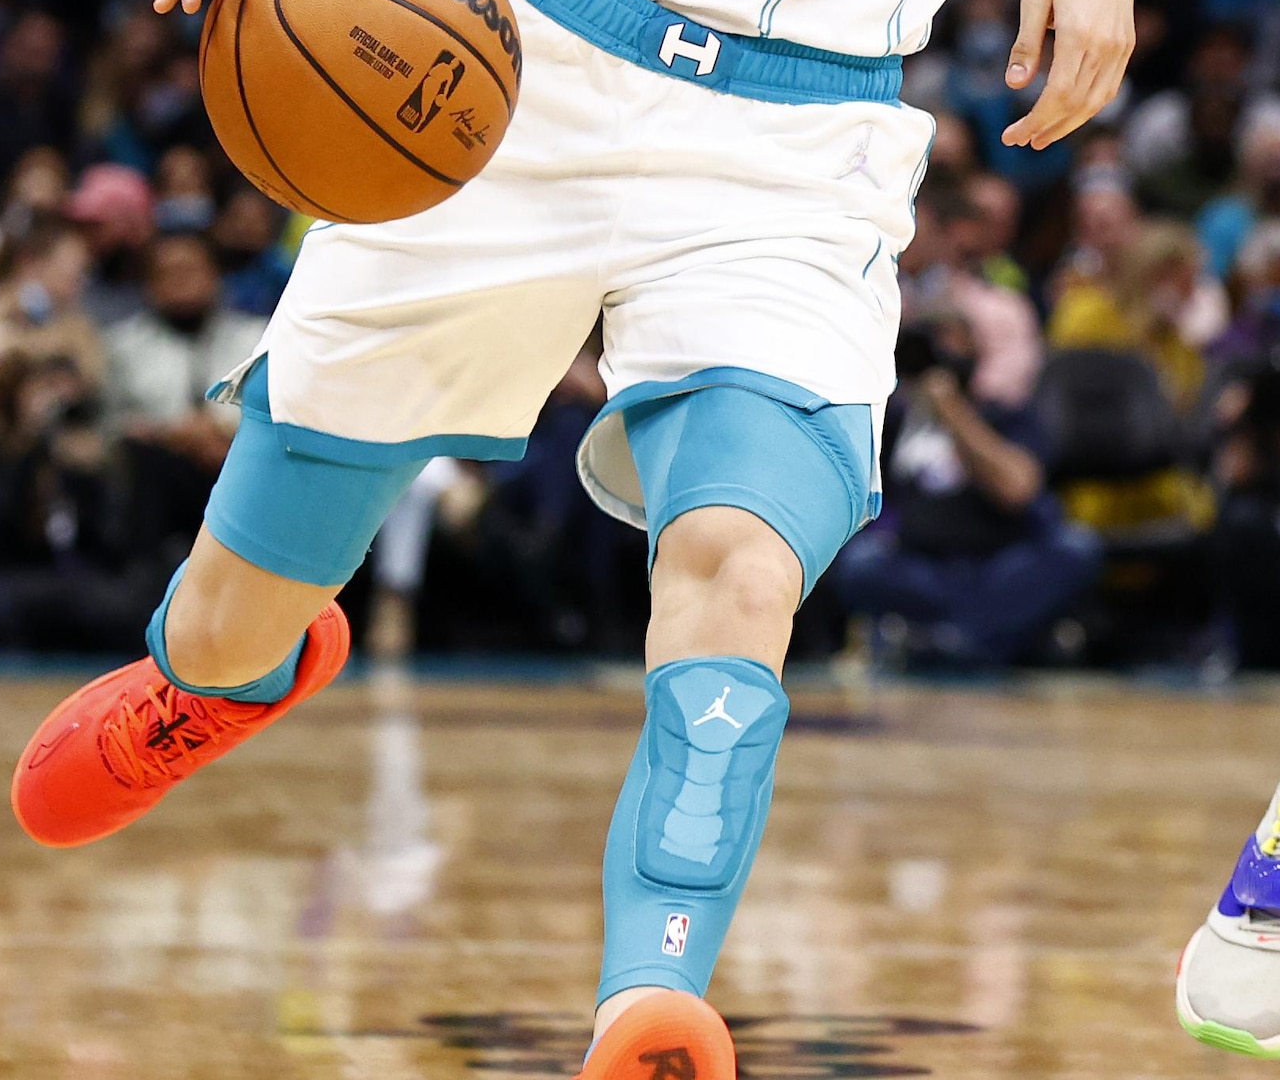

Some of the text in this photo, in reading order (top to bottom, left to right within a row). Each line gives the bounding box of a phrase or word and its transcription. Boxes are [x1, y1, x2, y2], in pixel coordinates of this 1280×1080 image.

[349, 25, 414, 78] OFFICIAL GAME BALL
